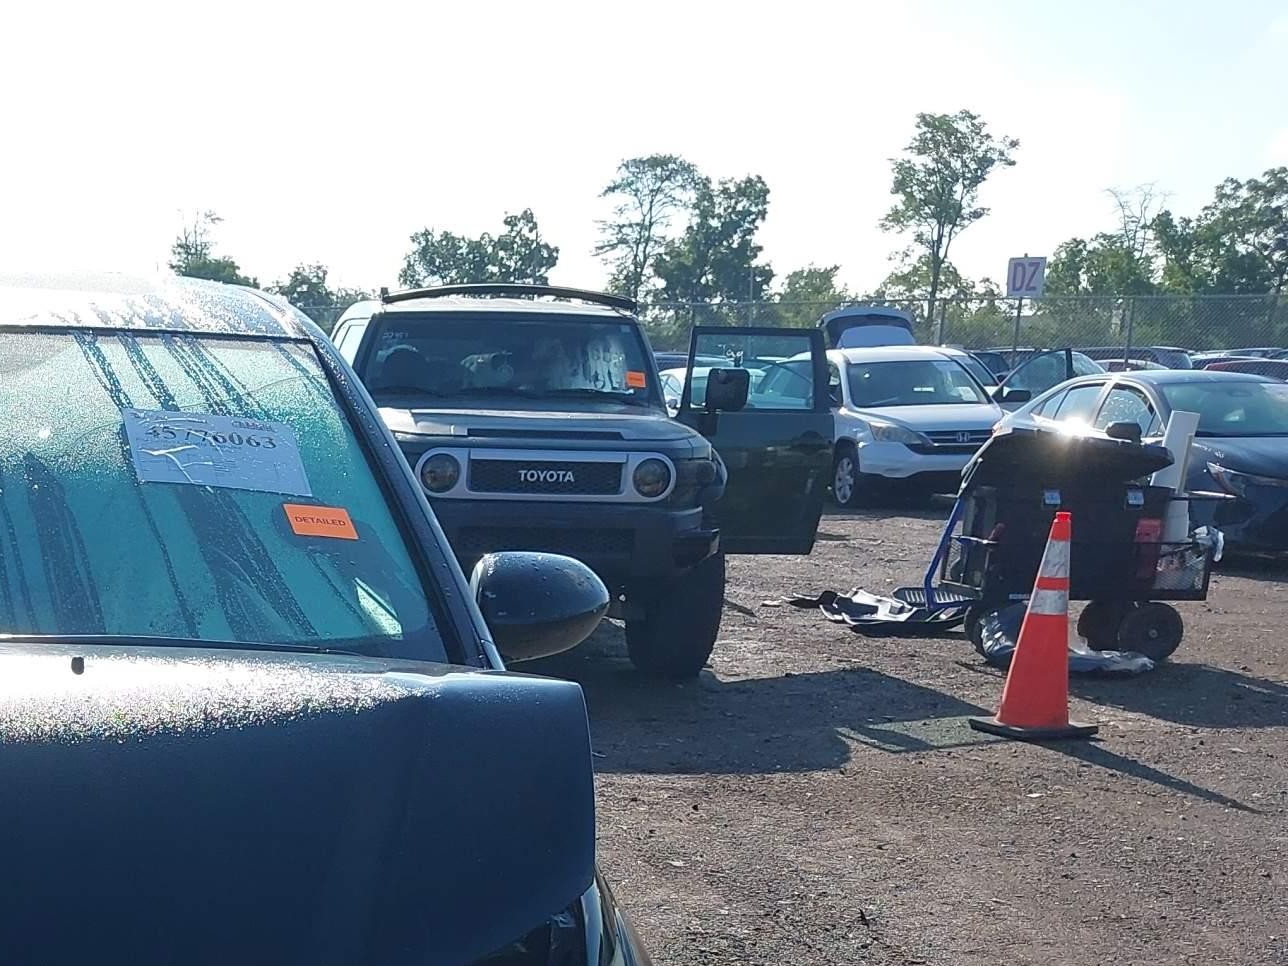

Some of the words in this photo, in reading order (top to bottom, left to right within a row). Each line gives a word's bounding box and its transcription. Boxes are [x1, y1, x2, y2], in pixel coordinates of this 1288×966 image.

[1012, 261, 1041, 291] DZ
[518, 470, 575, 482] TOYOTA
[294, 516, 346, 526] DETAILED
